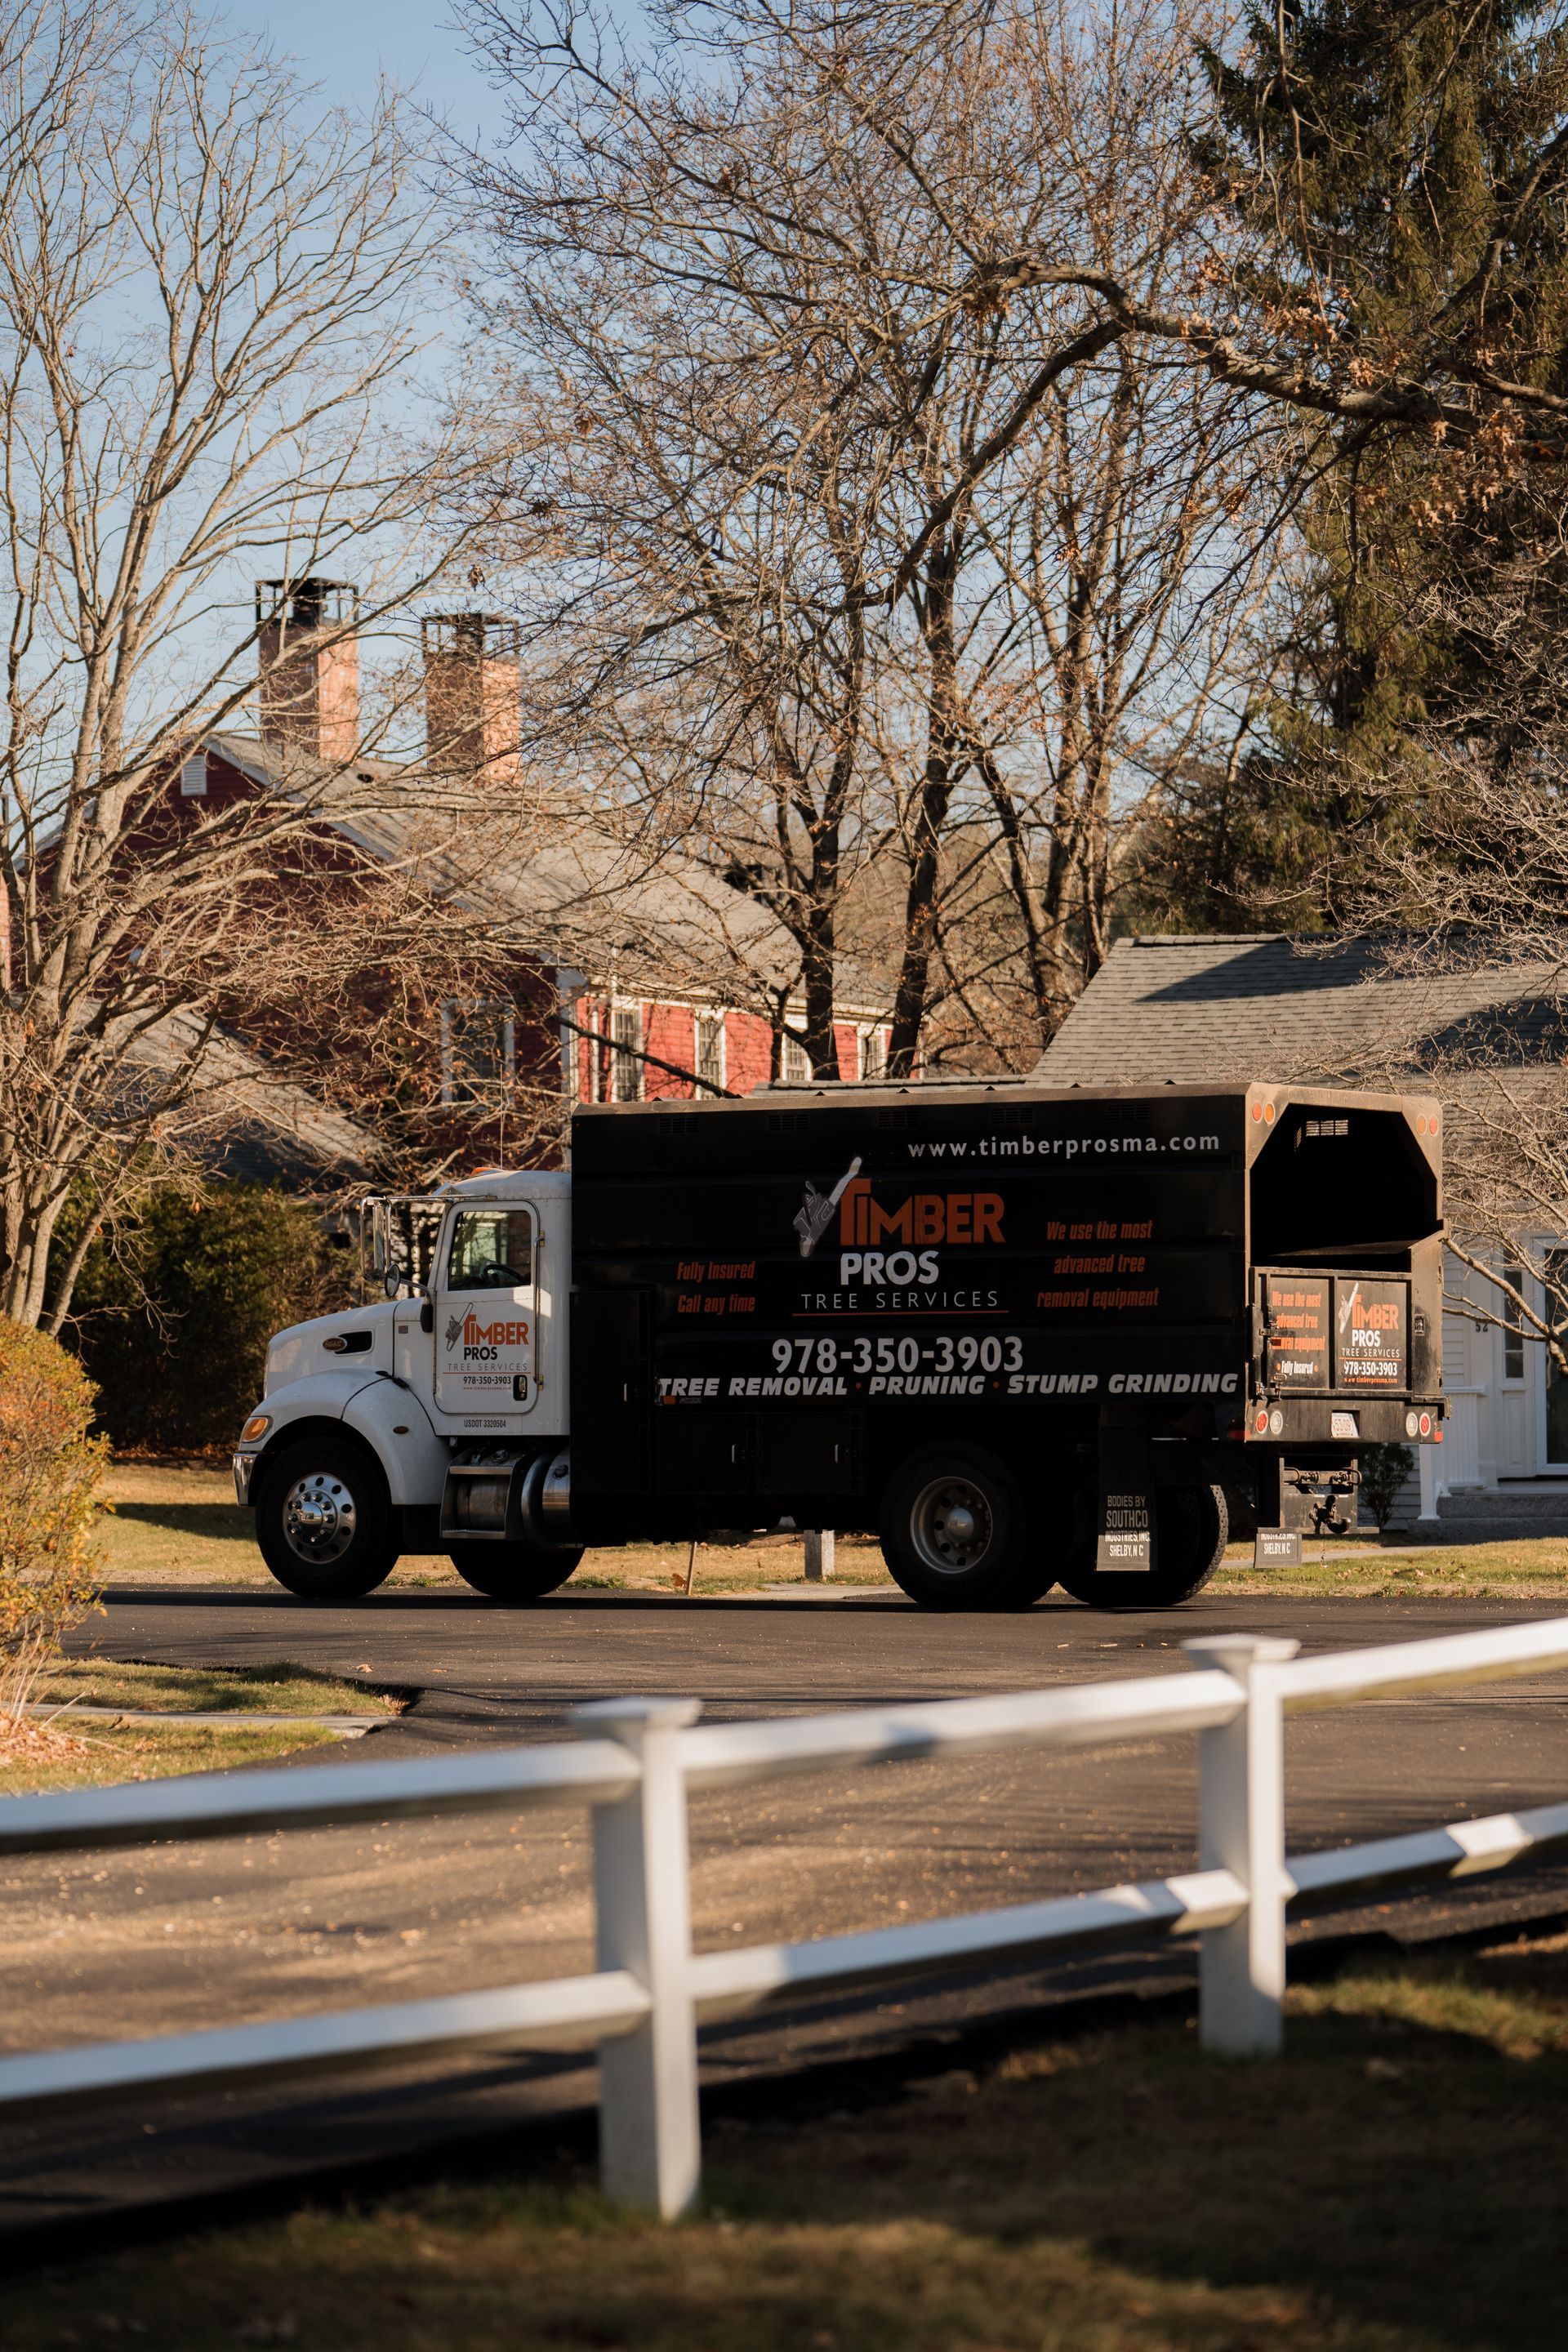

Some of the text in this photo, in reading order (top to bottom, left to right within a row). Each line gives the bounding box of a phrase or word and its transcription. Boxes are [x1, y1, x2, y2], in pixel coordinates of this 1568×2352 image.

[907, 1135, 1219, 1159] www.timberprosma.com
[840, 1178, 1006, 1246] TIMBER
[1047, 1220, 1153, 1240] We use the most
[677, 1261, 756, 1283] Fully Insured
[840, 1250, 939, 1285] PROS
[1054, 1254, 1146, 1274] advanced tree
[678, 1294, 755, 1316] Call any time
[801, 1290, 998, 1309] TREE SERVICES
[1036, 1288, 1160, 1310] removal equipment
[1272, 1290, 1321, 1307] We use the most
[1305, 1313, 1318, 1329] tree
[1352, 1294, 1399, 1330] TIMBER
[464, 1314, 529, 1346] TIMBER
[1352, 1330, 1381, 1347] PROS
[1294, 1335, 1325, 1353] equipment
[1342, 1348, 1400, 1358] TREE SERVICES
[463, 1347, 498, 1361] PROS
[772, 1337, 1023, 1374] 978-350-3903
[448, 1362, 528, 1371] TREE SERVICES
[1281, 1360, 1314, 1375] Fully Insured
[1343, 1361, 1398, 1376] 978-350-3903
[463, 1376, 511, 1384] 978-350-3903
[659, 1373, 1238, 1396] TREE REMOVAL PRUNING STUMP GRINDING
[464, 1419, 483, 1428] USDOT
[1107, 1495, 1146, 1508] BODIES BY
[1106, 1510, 1148, 1528] SOUTHCO
